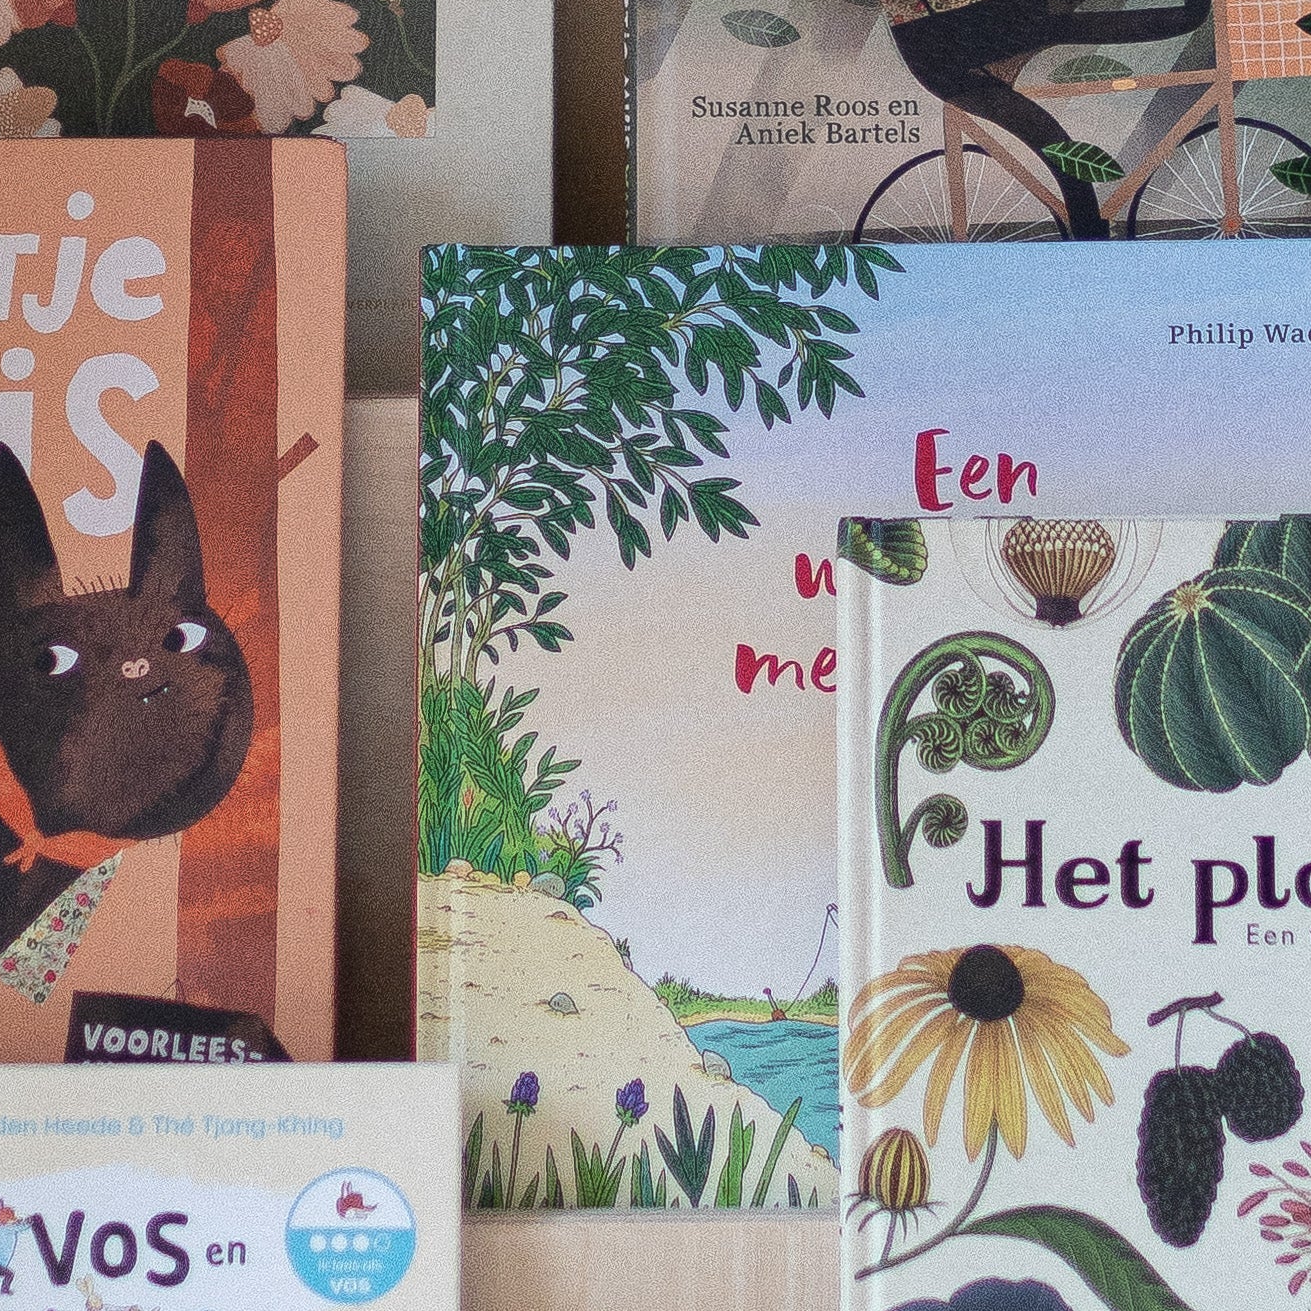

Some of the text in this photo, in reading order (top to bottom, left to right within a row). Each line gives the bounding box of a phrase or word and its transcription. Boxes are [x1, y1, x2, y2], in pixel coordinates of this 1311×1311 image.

[691, 94, 920, 122] Susanne Roos en
[734, 119, 922, 146] Aniek Bartels
[1168, 321, 1255, 349] Philip
[911, 427, 1039, 514] Een
[966, 818, 1155, 910] Het
[1245, 922, 1292, 947] Een
[83, 1023, 264, 1066] VOORLEES-
[44, 1116, 122, 1136] Heede
[205, 1238, 247, 1268] en
